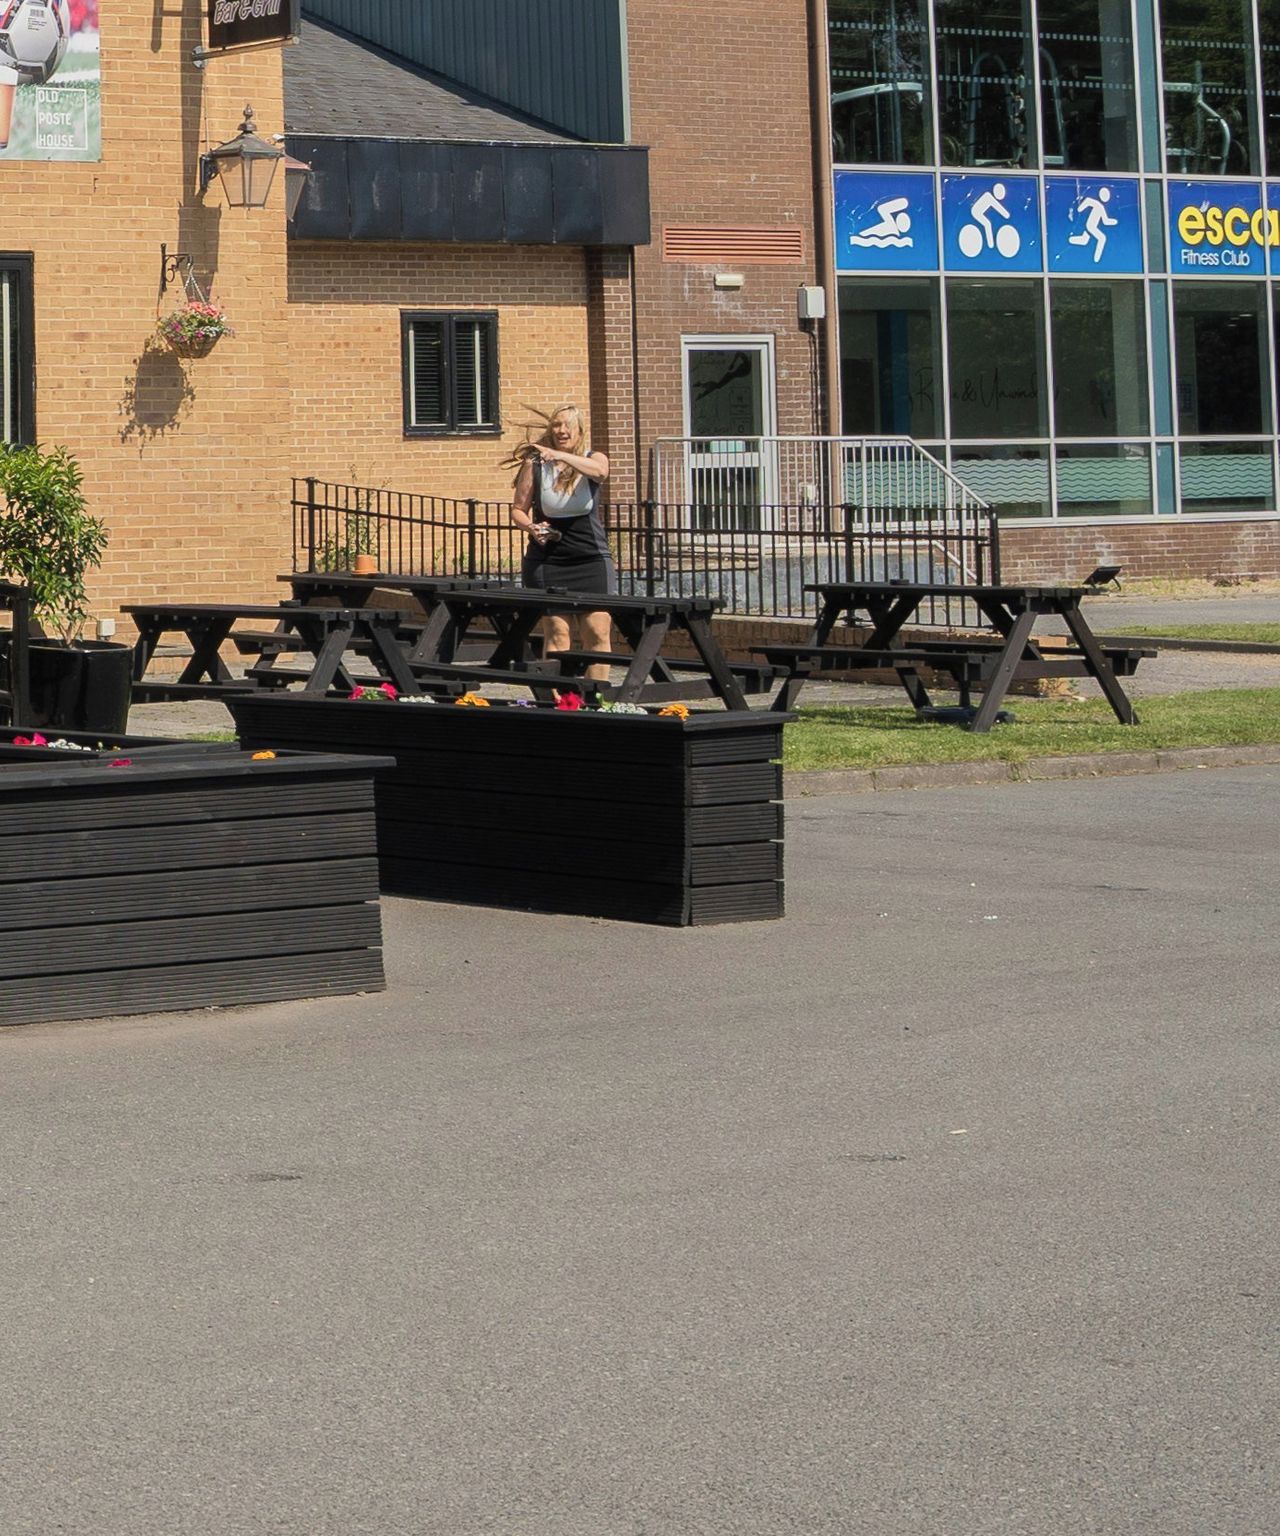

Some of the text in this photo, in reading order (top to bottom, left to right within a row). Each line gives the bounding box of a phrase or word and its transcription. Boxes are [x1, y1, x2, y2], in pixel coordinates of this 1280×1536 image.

[214, 0, 240, 25] Bar
[38, 90, 58, 103] OLD
[39, 112, 72, 125] POSTE
[39, 133, 74, 147] HOUSE
[1181, 249, 1251, 266] Fitness Club
